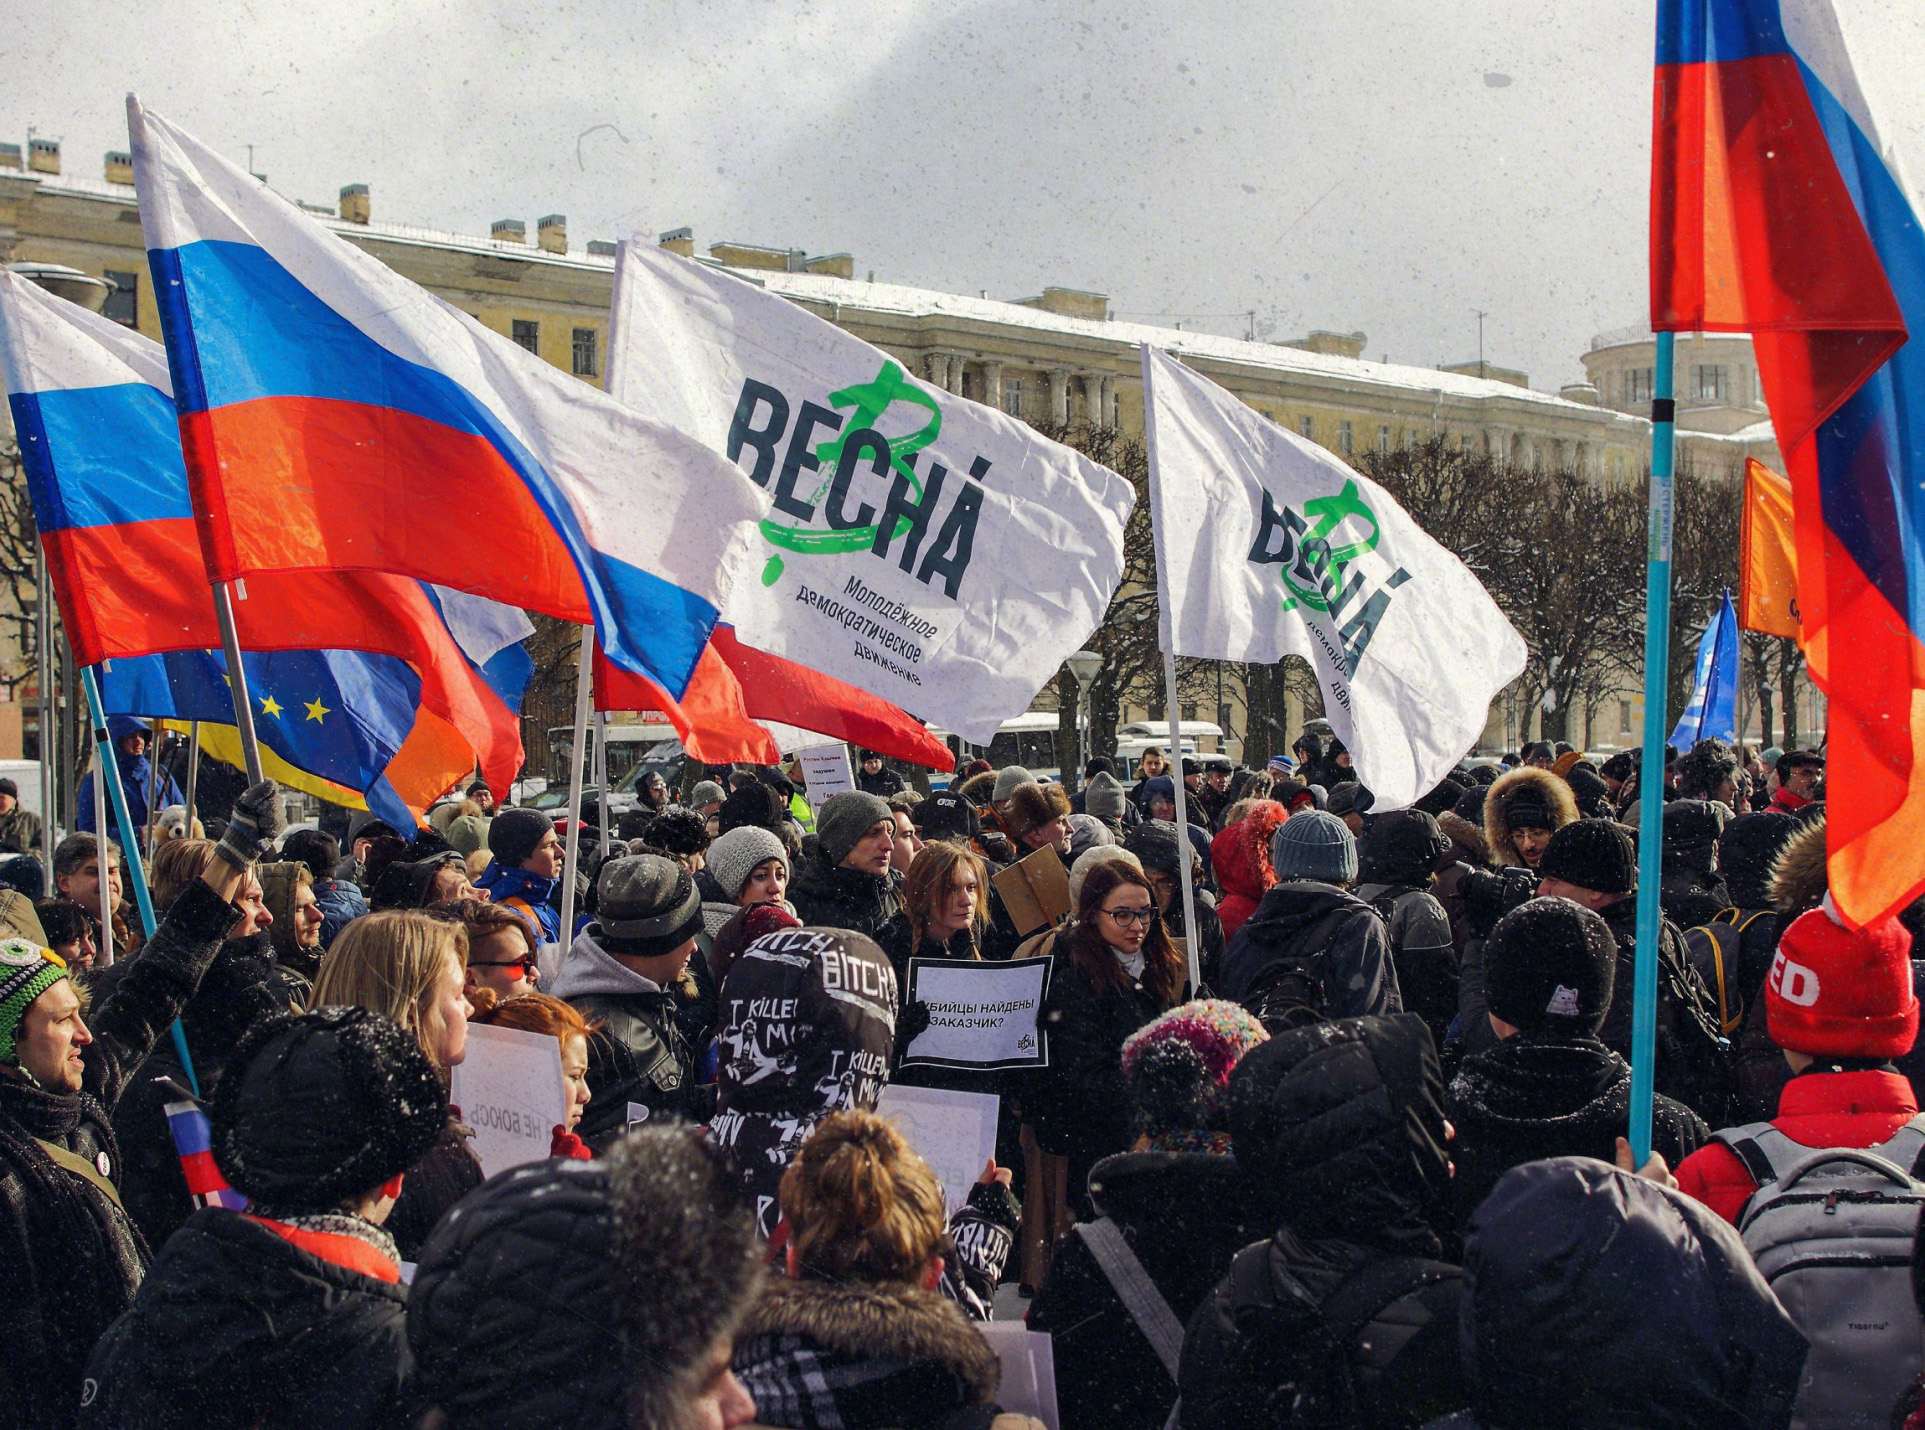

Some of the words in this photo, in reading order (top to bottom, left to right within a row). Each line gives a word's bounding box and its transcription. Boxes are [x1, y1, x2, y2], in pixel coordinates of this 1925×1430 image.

[796, 584, 922, 664] демократическое
[843, 575, 938, 640] Молодёжное
[854, 640, 922, 687] движение
[930, 1016, 1004, 1029] ЗАКАЗЧИК?
[980, 999, 1035, 1014] НАЙДЕНЫ
